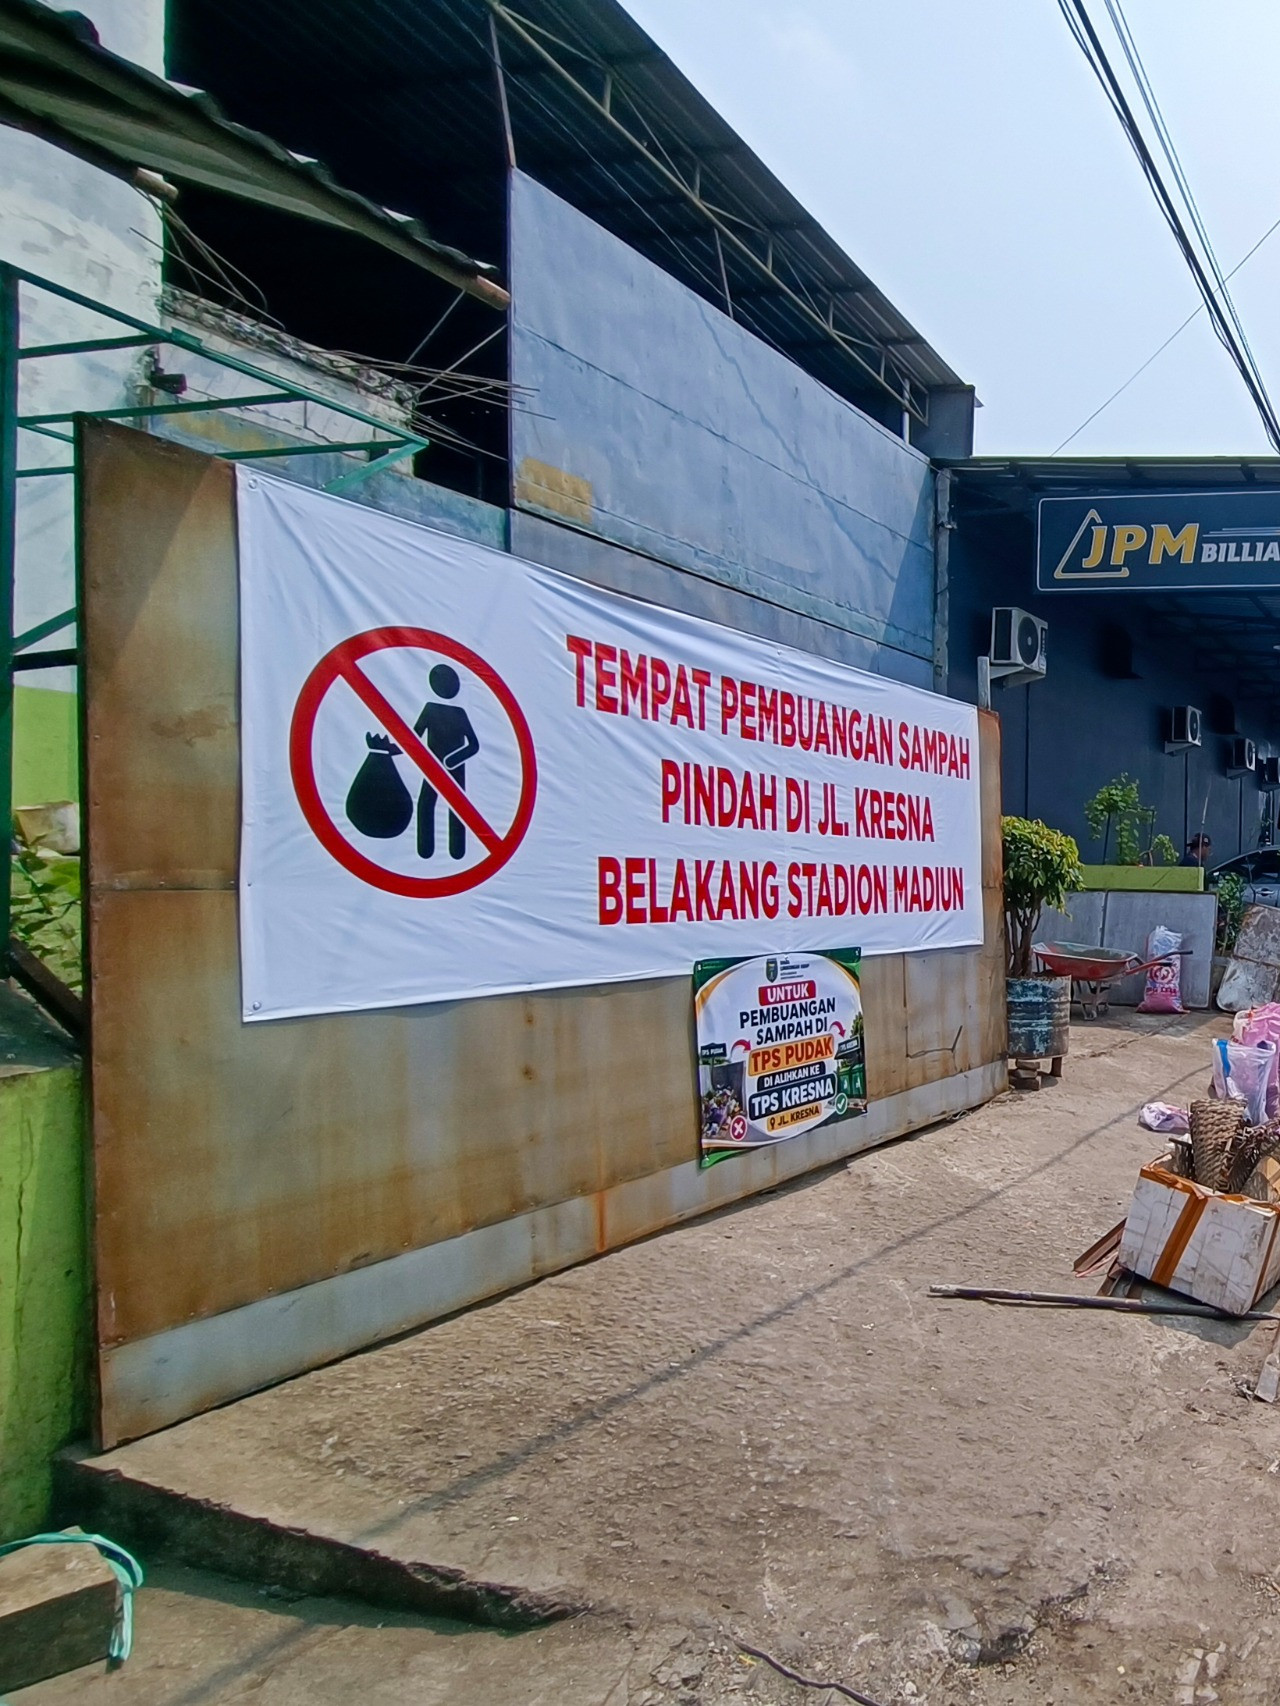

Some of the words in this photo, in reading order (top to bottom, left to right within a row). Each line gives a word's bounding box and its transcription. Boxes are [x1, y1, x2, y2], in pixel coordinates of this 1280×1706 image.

[1082, 523, 1199, 568] JPM
[566, 634, 711, 727] TEMPAT
[721, 674, 893, 767] PEMBUANGAN
[899, 719, 971, 781] SAMPAH
[661, 759, 777, 833] PINDAH
[786, 778, 810, 833] DI
[817, 785, 850, 838] JL.
[856, 788, 935, 843] KRESNA
[598, 856, 778, 926] BELAKANG
[787, 863, 889, 917] STADION
[894, 866, 965, 914] MADIUN
[767, 982, 810, 1003] UNTUK
[739, 997, 836, 1029] PEMBUANGAN
[756, 1020, 813, 1046] SAMPAH
[815, 1016, 828, 1034] DI
[751, 1050, 781, 1073] TPS
[785, 1036, 833, 1066] PUDAK
[763, 1077, 774, 1088] DI
[774, 1069, 808, 1086] ALIHKAN
[809, 1065, 821, 1078] KE
[751, 1096, 780, 1118] TPS
[782, 1078, 834, 1109] KRESNA
[790, 1105, 820, 1122] KRESNA
